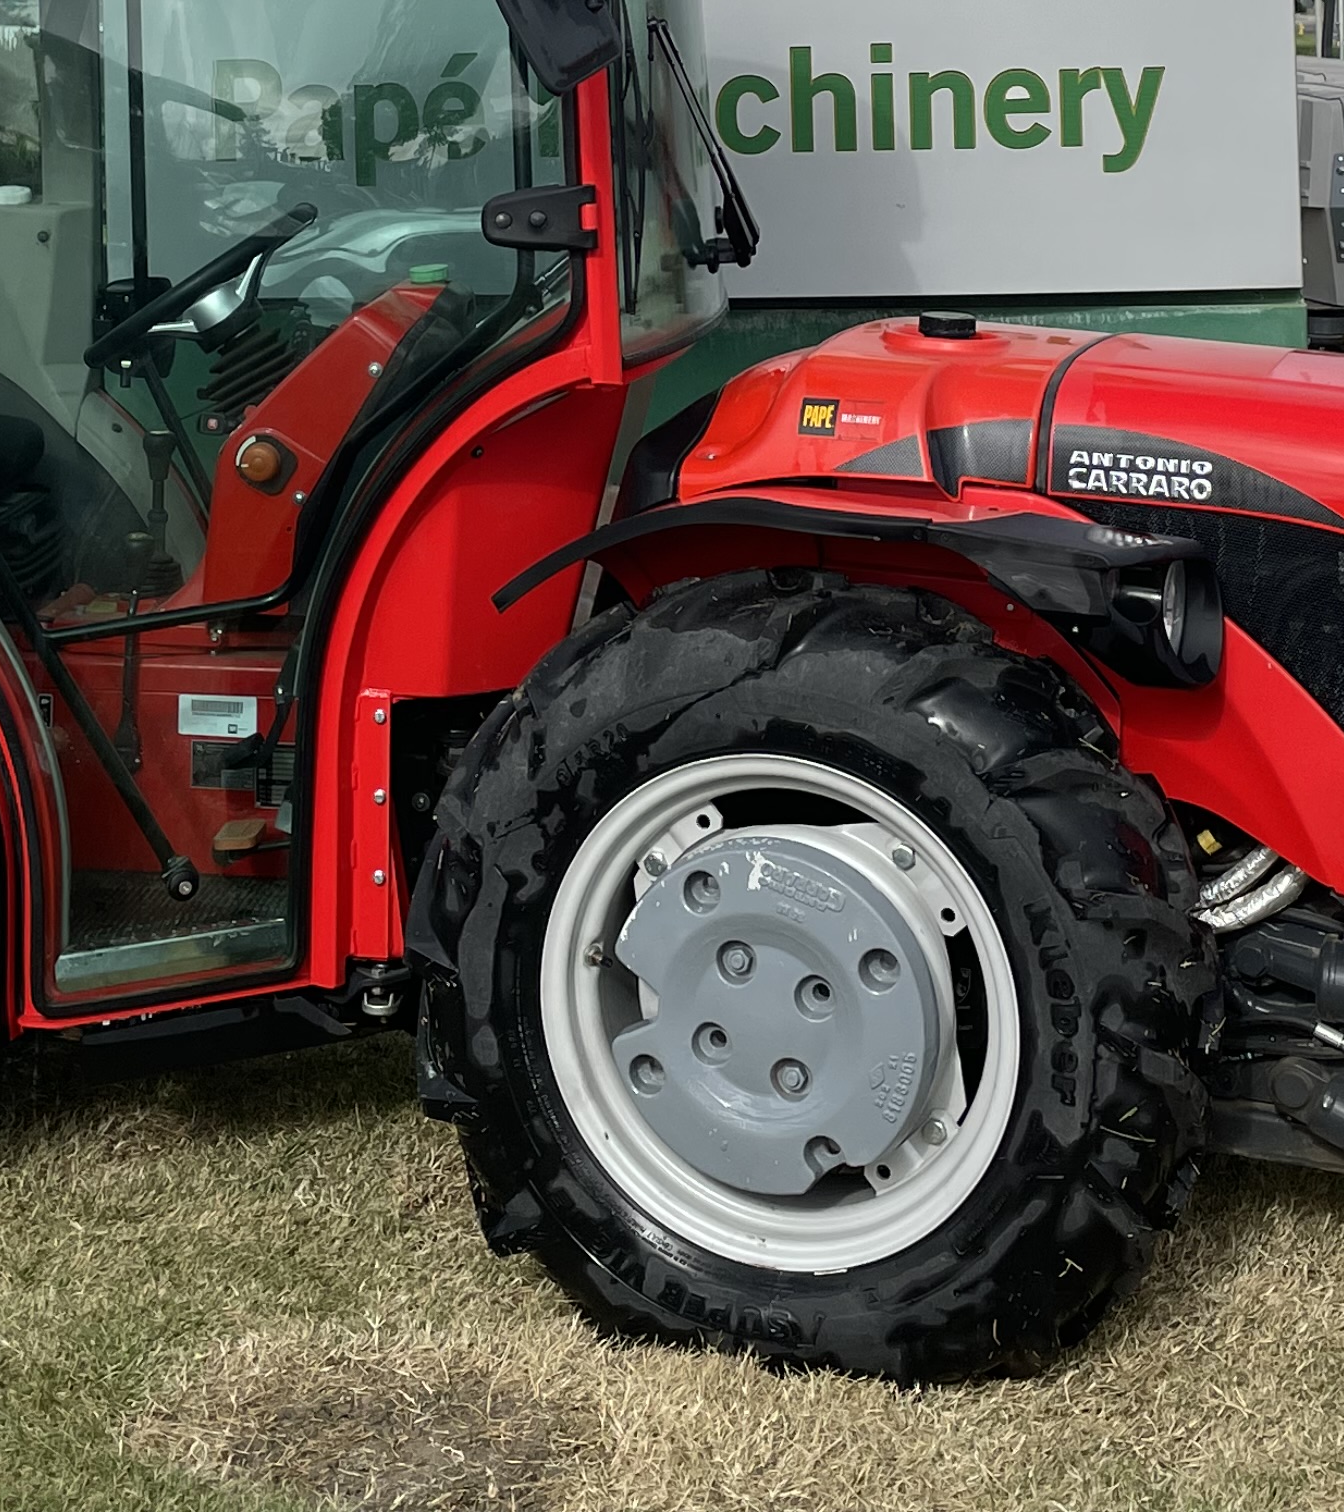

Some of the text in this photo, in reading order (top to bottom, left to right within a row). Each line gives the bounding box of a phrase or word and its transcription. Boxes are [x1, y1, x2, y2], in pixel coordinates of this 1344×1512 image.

[213, 43, 1166, 187] Papé chinery
[1067, 467, 1213, 501] CARRARO
[1068, 450, 1214, 476] ANTONIO
[1022, 896, 1083, 1108] Kleber
